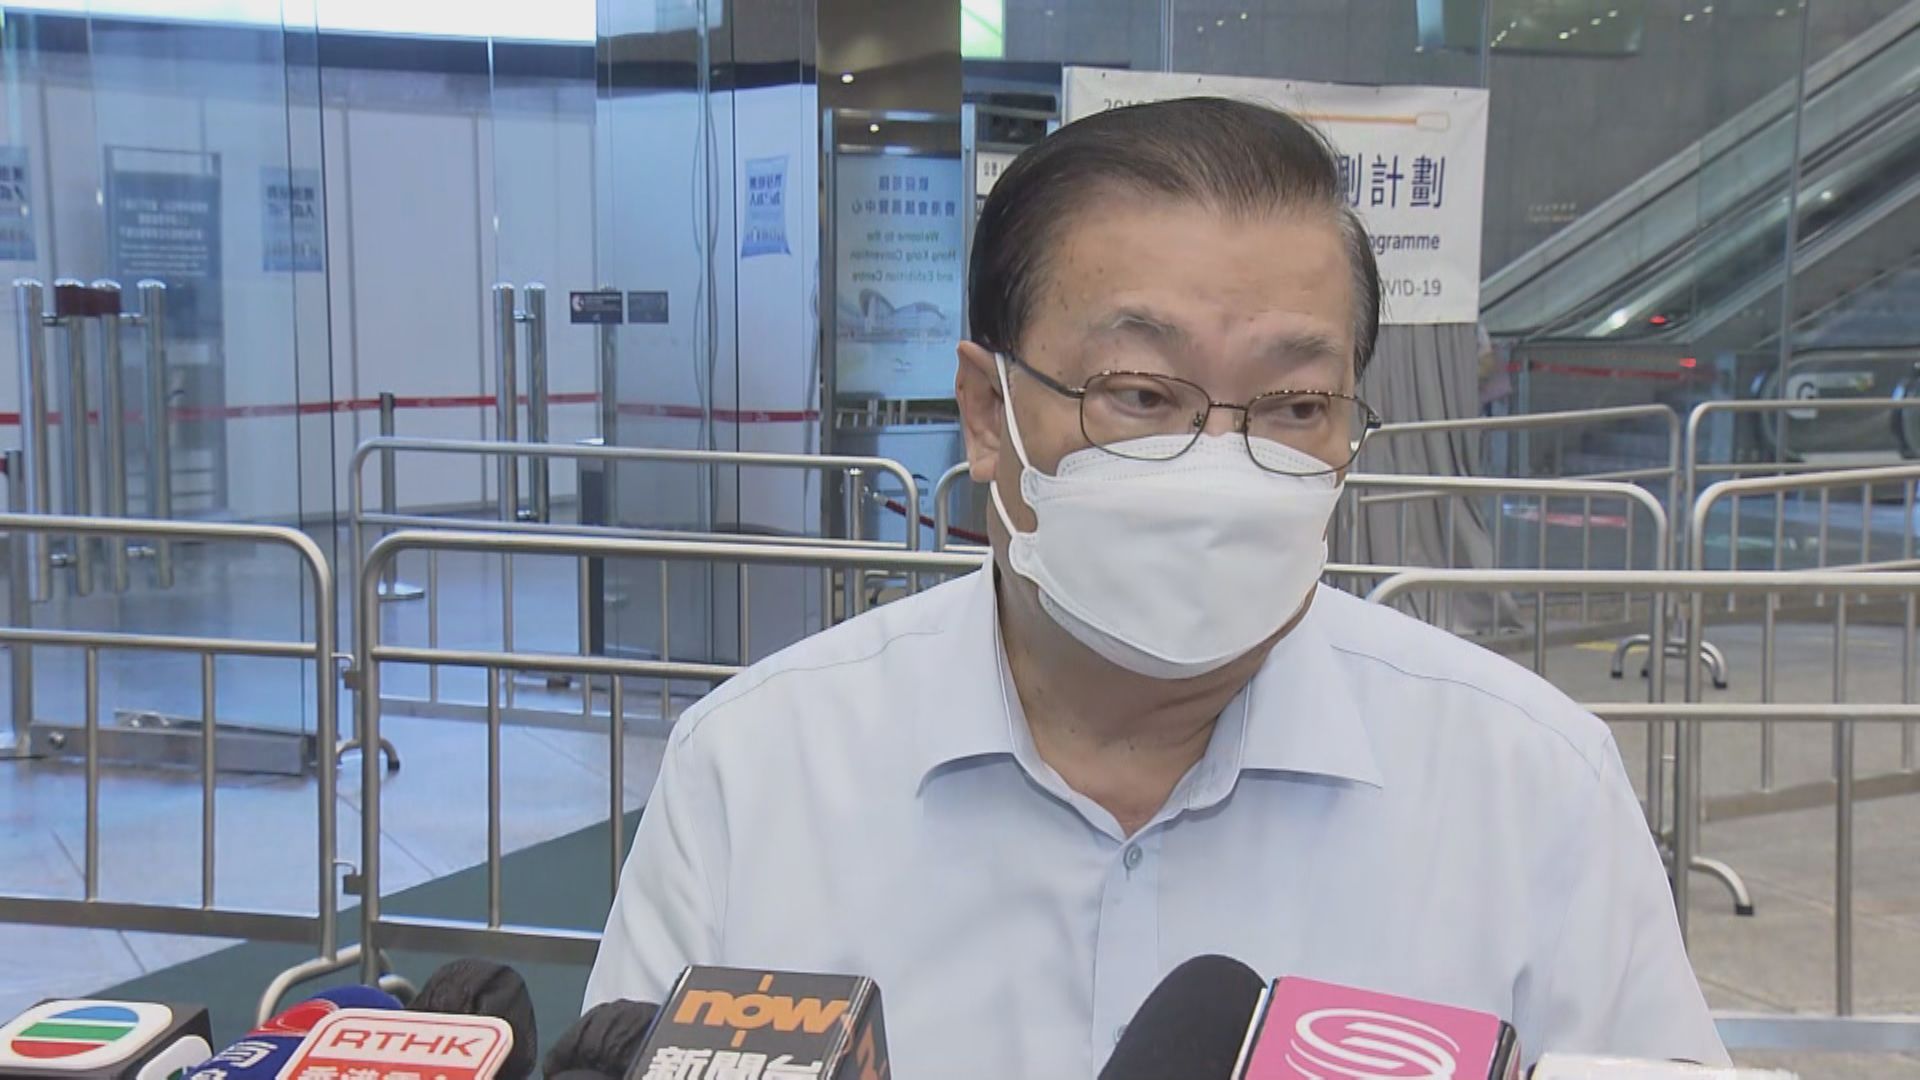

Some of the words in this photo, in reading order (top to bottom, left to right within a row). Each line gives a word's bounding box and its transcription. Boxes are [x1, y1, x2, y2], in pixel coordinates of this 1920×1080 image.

[1369, 234, 1440, 255] ogramme
[1386, 279, 1442, 296] VID-19
[673, 990, 849, 1034] now
[330, 1029, 482, 1057] RTHK
